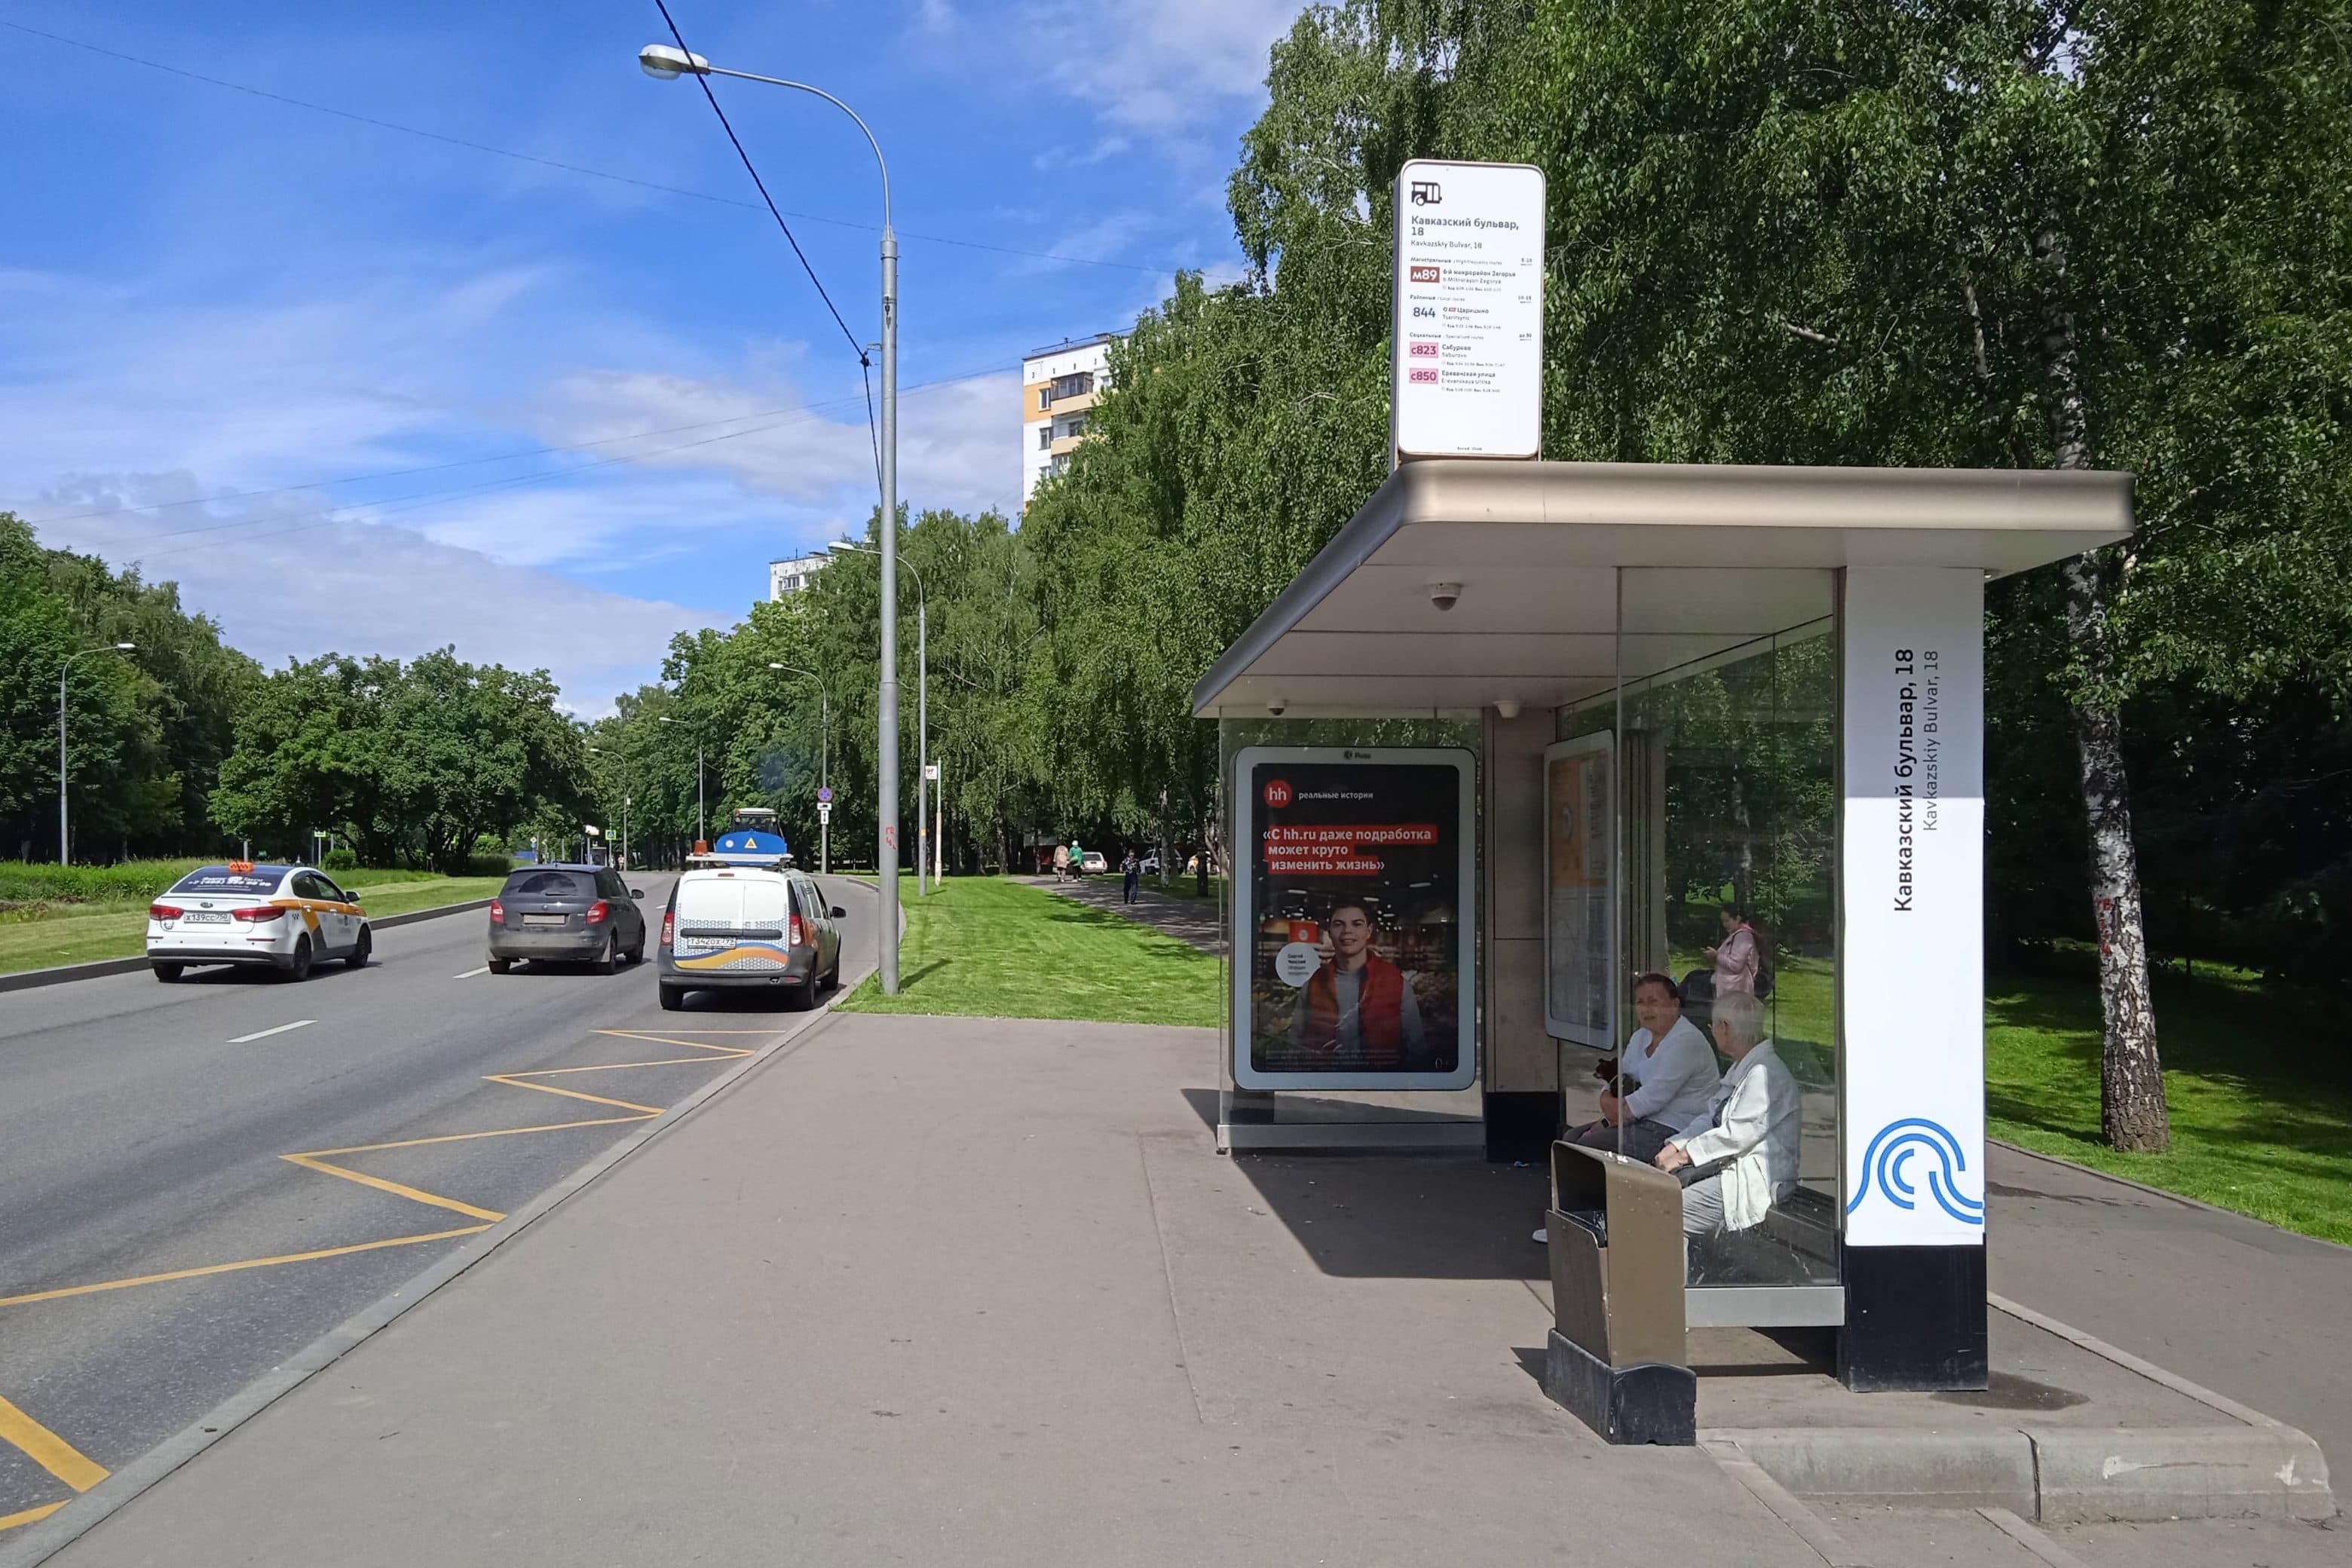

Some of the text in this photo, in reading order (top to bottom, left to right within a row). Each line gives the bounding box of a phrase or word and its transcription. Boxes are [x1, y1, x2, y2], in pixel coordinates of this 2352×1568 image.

[1411, 216, 1519, 230] Кавказский бульвар,
[1411, 226, 1424, 236] 18
[1411, 240, 1447, 248] Kavkazskiy
[1413, 269, 1438, 280] м89
[1413, 307, 1435, 318] 844
[1411, 345, 1436, 355] с823
[1410, 372, 1436, 381] с850
[1923, 651, 1940, 831] Kavkazskiy Bulvar, 18
[1894, 649, 1918, 911] Кавказский бульвар, 18
[1269, 788, 1287, 801] hh
[1298, 792, 1374, 800] реальные истории
[1284, 828, 1316, 840] hh.ru
[1319, 831, 1352, 842] даже
[1356, 828, 1432, 843] подработка
[1268, 845, 1348, 857] может круто
[1271, 860, 1385, 871] изменить жизнь»
